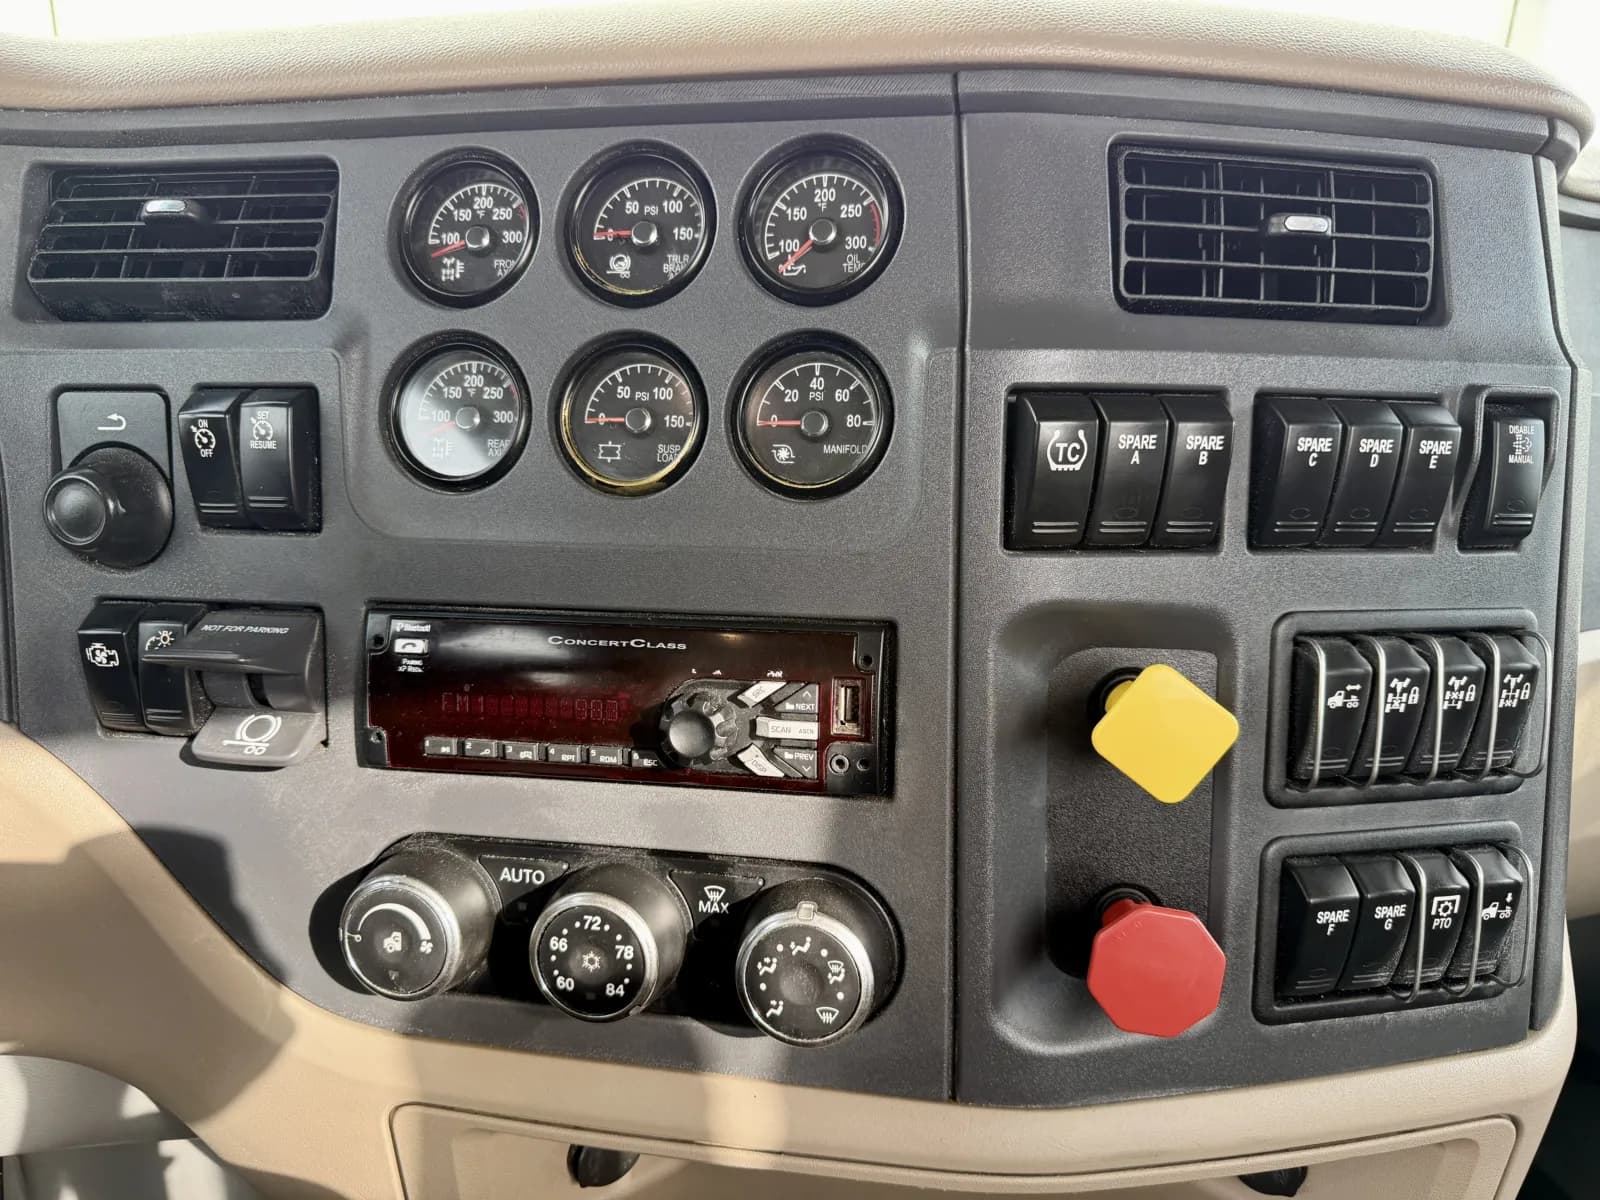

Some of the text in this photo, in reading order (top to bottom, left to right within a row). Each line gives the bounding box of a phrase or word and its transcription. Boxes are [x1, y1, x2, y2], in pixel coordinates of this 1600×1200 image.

[814, 188, 836, 202] 200
[473, 196, 494, 209] 200
[625, 202, 640, 214] 50
[662, 201, 683, 213] 100
[453, 209, 472, 221] 150
[492, 208, 512, 220] 250
[644, 206, 658, 216] PSI
[786, 207, 807, 220] 150
[840, 204, 862, 218] 250
[441, 232, 460, 244] 100
[502, 231, 522, 244] 300
[673, 228, 693, 240] 150
[779, 240, 800, 252] 100
[845, 236, 867, 250] 300
[846, 254, 860, 264] OIL
[464, 375, 484, 387] 200
[810, 377, 824, 390] 40
[443, 387, 462, 398] 150
[483, 387, 504, 399] 250
[616, 386, 630, 398] 50
[635, 392, 650, 400] PSI
[653, 387, 673, 400] 100
[784, 389, 798, 402] 20
[810, 392, 824, 400] PSI
[835, 389, 850, 402] 60
[257, 411, 270, 420] SET
[432, 410, 450, 422] 100
[494, 411, 514, 423] 300
[664, 415, 684, 428] 150
[846, 414, 860, 427] 80
[198, 419, 208, 428] ON
[1508, 424, 1534, 434] DISABLE
[250, 440, 277, 450] RESUME
[1118, 434, 1158, 450] SPARE
[1186, 435, 1224, 450] SPARE
[1297, 437, 1332, 452] SPARE
[1359, 438, 1394, 454] SPARE
[1419, 440, 1452, 455] SPARE
[200, 449, 214, 458] OFF
[658, 444, 680, 454] SUSP
[824, 445, 868, 454] MANIFOLD
[1056, 443, 1080, 462] TC
[1130, 452, 1140, 464] A
[1198, 452, 1208, 465] B
[1308, 453, 1318, 467] C
[1370, 454, 1378, 468] D
[1429, 456, 1438, 469] E
[1508, 454, 1534, 464] MANUAL
[770, 726, 792, 734] SCAN
[794, 752, 814, 760] PREV
[500, 867, 544, 884] AUTO
[698, 901, 729, 914] MAX
[1374, 904, 1406, 919] SPARE
[583, 916, 601, 930] 72
[1316, 909, 1350, 925] SPARE
[1432, 917, 1452, 930] PTO
[1327, 924, 1334, 936] F
[1384, 918, 1392, 930] G
[550, 936, 568, 952] 66
[615, 945, 634, 960] 78
[556, 976, 574, 991] 60
[606, 984, 624, 997] 84
